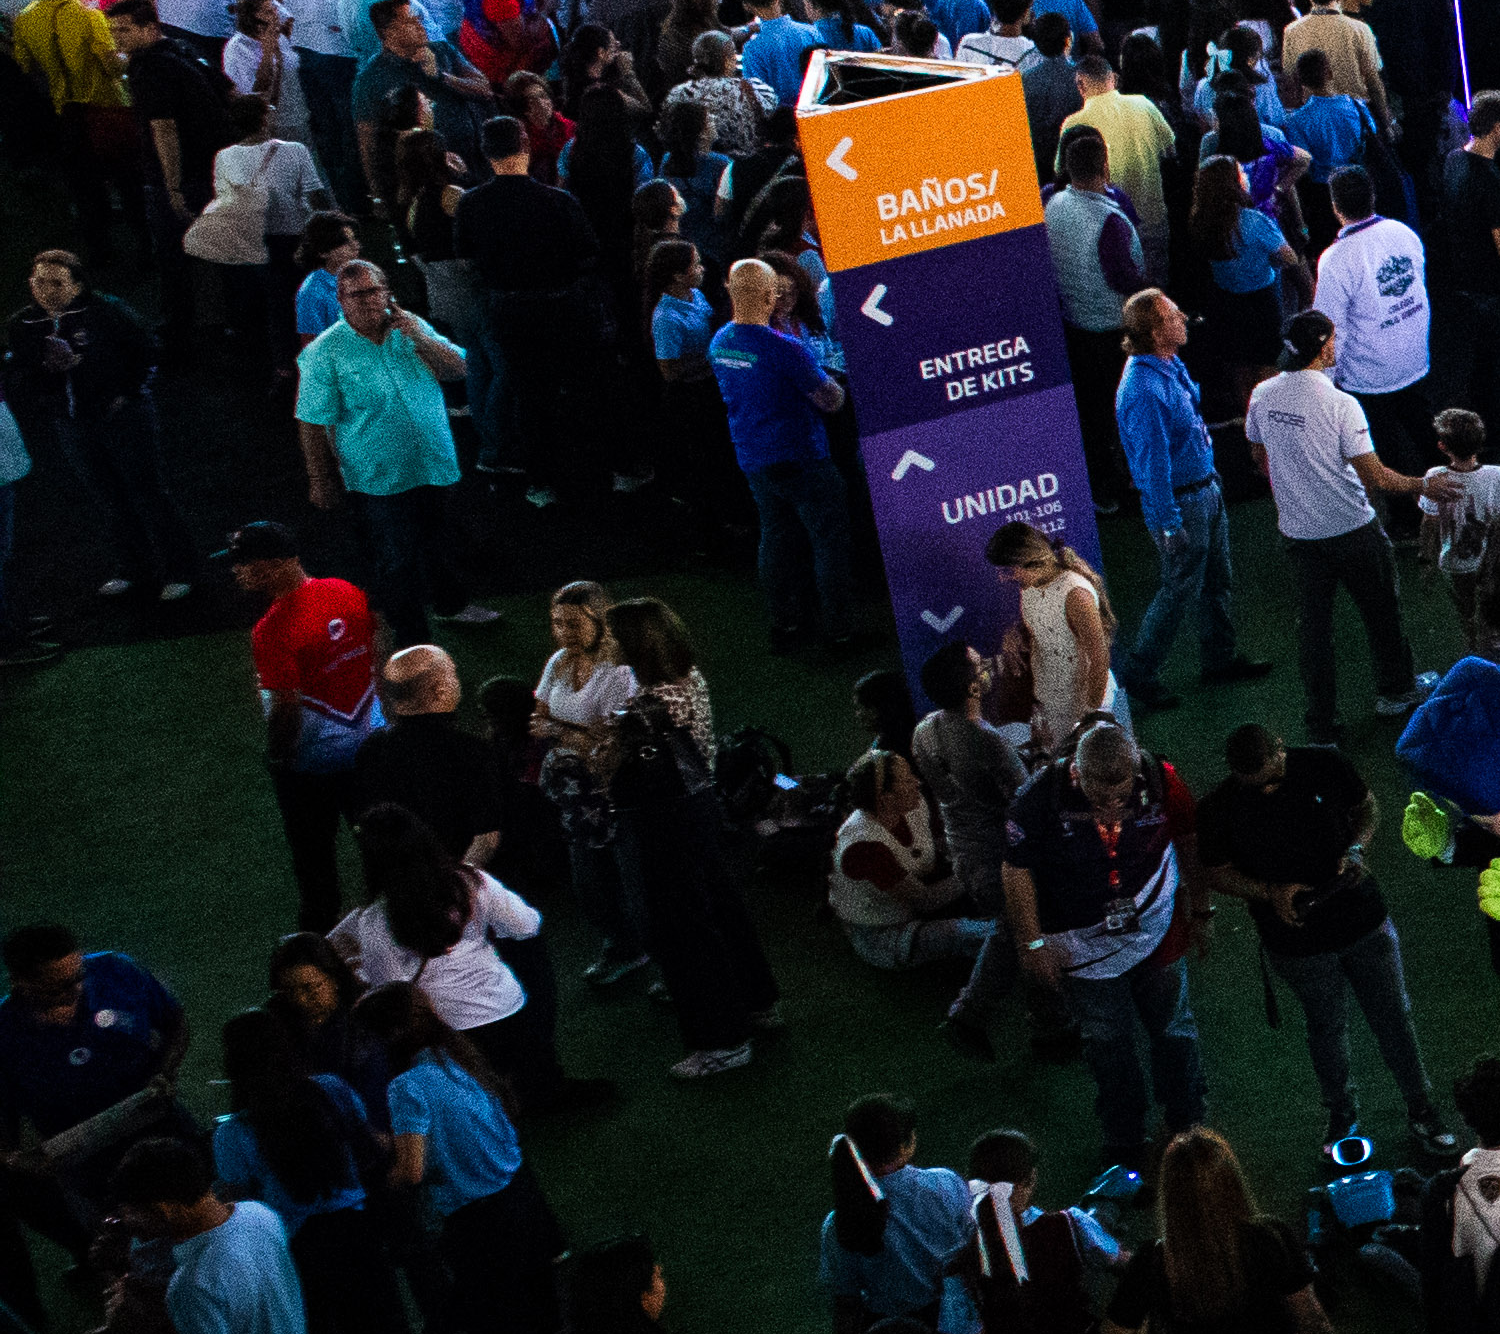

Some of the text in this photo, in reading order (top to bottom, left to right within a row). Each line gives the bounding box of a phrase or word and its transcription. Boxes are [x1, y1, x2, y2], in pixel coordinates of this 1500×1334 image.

[877, 170, 998, 221] BAÑOS/
[880, 202, 1005, 246] LA LLANADA
[919, 336, 1030, 380] ENTREGA
[945, 362, 1034, 402] DE KITS
[942, 473, 1059, 524] UNIDAD
